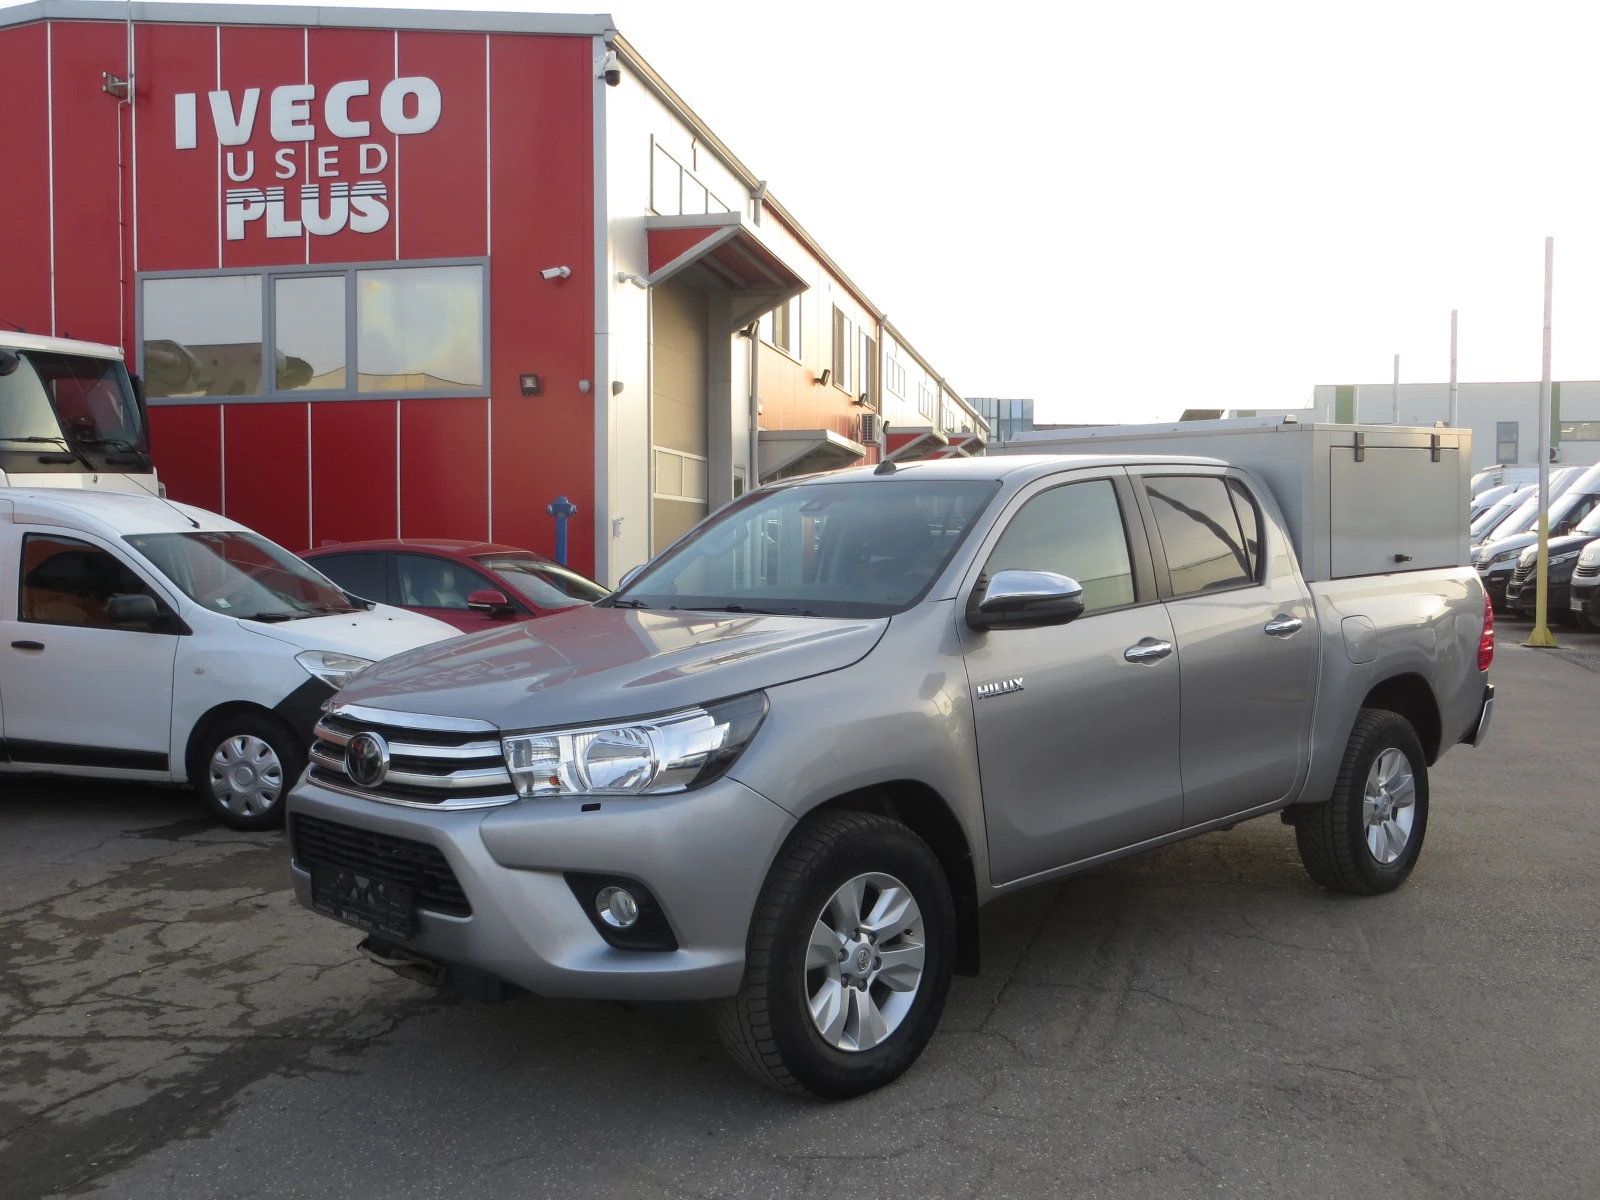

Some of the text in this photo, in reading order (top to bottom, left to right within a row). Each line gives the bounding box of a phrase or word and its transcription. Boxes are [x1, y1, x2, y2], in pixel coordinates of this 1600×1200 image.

[174, 76, 442, 150] IVECO
[226, 143, 388, 182] USED
[225, 180, 390, 241] PLUS
[976, 677, 1024, 700] HILUX
